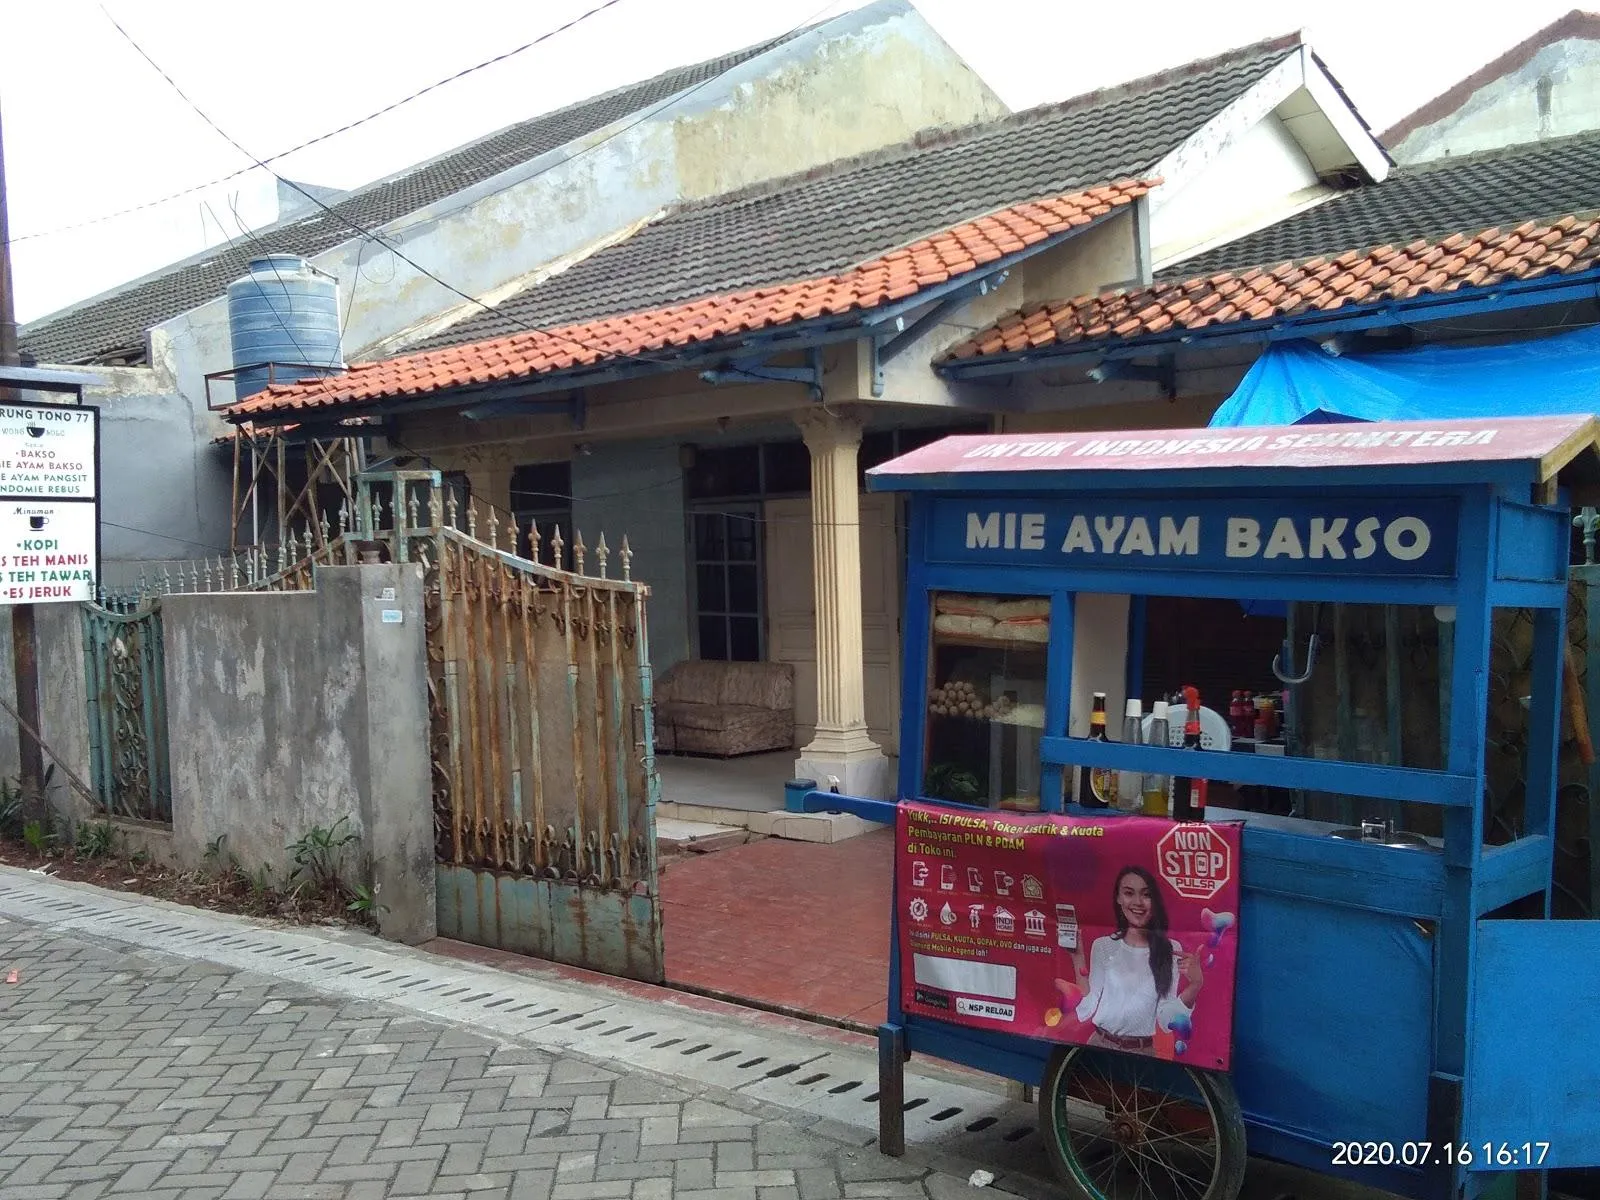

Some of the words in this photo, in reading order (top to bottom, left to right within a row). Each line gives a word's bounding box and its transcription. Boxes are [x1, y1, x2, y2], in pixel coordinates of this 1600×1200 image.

[37, 410, 72, 422] TONO
[76, 413, 89, 423] 77
[962, 440, 1076, 458] UNTUK
[1071, 435, 1270, 457] INDONESIA
[21, 449, 56, 459] BAKSO
[0, 460, 12, 469] IE
[16, 461, 44, 470] AYAM
[49, 461, 83, 471] BAKSO
[10, 473, 40, 482] AYAM
[44, 473, 87, 482] PANGSIT
[48, 485, 81, 494] REBUS
[13, 507, 54, 515] Minuman
[966, 512, 1045, 550] MIE
[1062, 515, 1200, 555] AYAM
[1225, 516, 1431, 561] BAKSO
[23, 539, 58, 550] KOPI
[12, 555, 40, 567] TEH
[45, 554, 88, 566] MANIS
[8, 570, 35, 582] TEH
[41, 569, 91, 582] TAWAR
[9, 587, 24, 599] ES
[28, 585, 72, 599] JERUK
[1023, 825, 1058, 836] Listrik
[1059, 827, 1069, 836] &
[1070, 826, 1105, 837] Kuota
[908, 827, 963, 843] Pembayaran
[964, 834, 983, 846] PLN
[985, 835, 993, 847] &
[994, 836, 1025, 850] PDAM
[1174, 831, 1212, 850] NON
[907, 843, 918, 854] di
[919, 844, 942, 856] Toko
[1165, 851, 1223, 878] STOP
[1175, 878, 1216, 889] PULSA
[968, 1003, 984, 1013] NSP
[985, 1005, 1014, 1017] RELOAD
